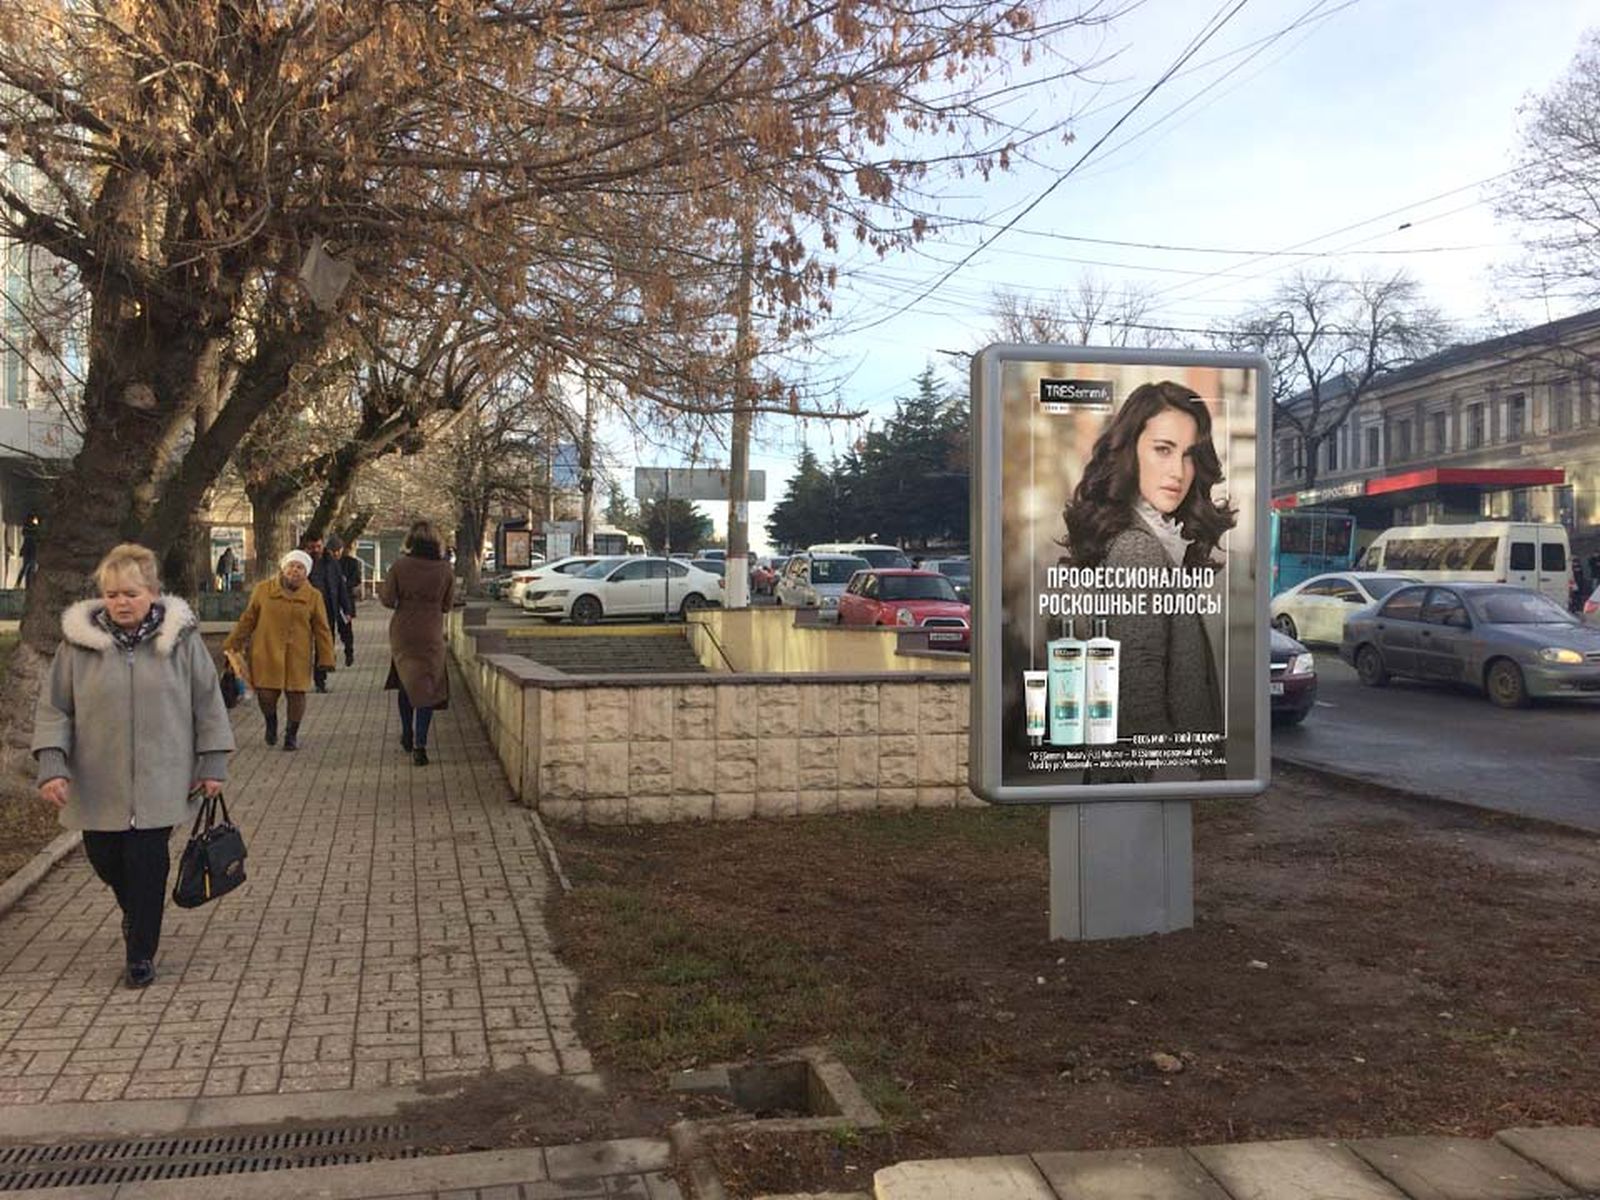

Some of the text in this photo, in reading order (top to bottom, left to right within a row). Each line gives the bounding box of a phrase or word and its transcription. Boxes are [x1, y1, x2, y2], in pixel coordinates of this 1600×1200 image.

[1047, 567, 1215, 589] ПРОФЕССИОНАЛЬНО
[1039, 593, 1222, 615] РОСКОШНЫЕ ВОЛОСЫ
